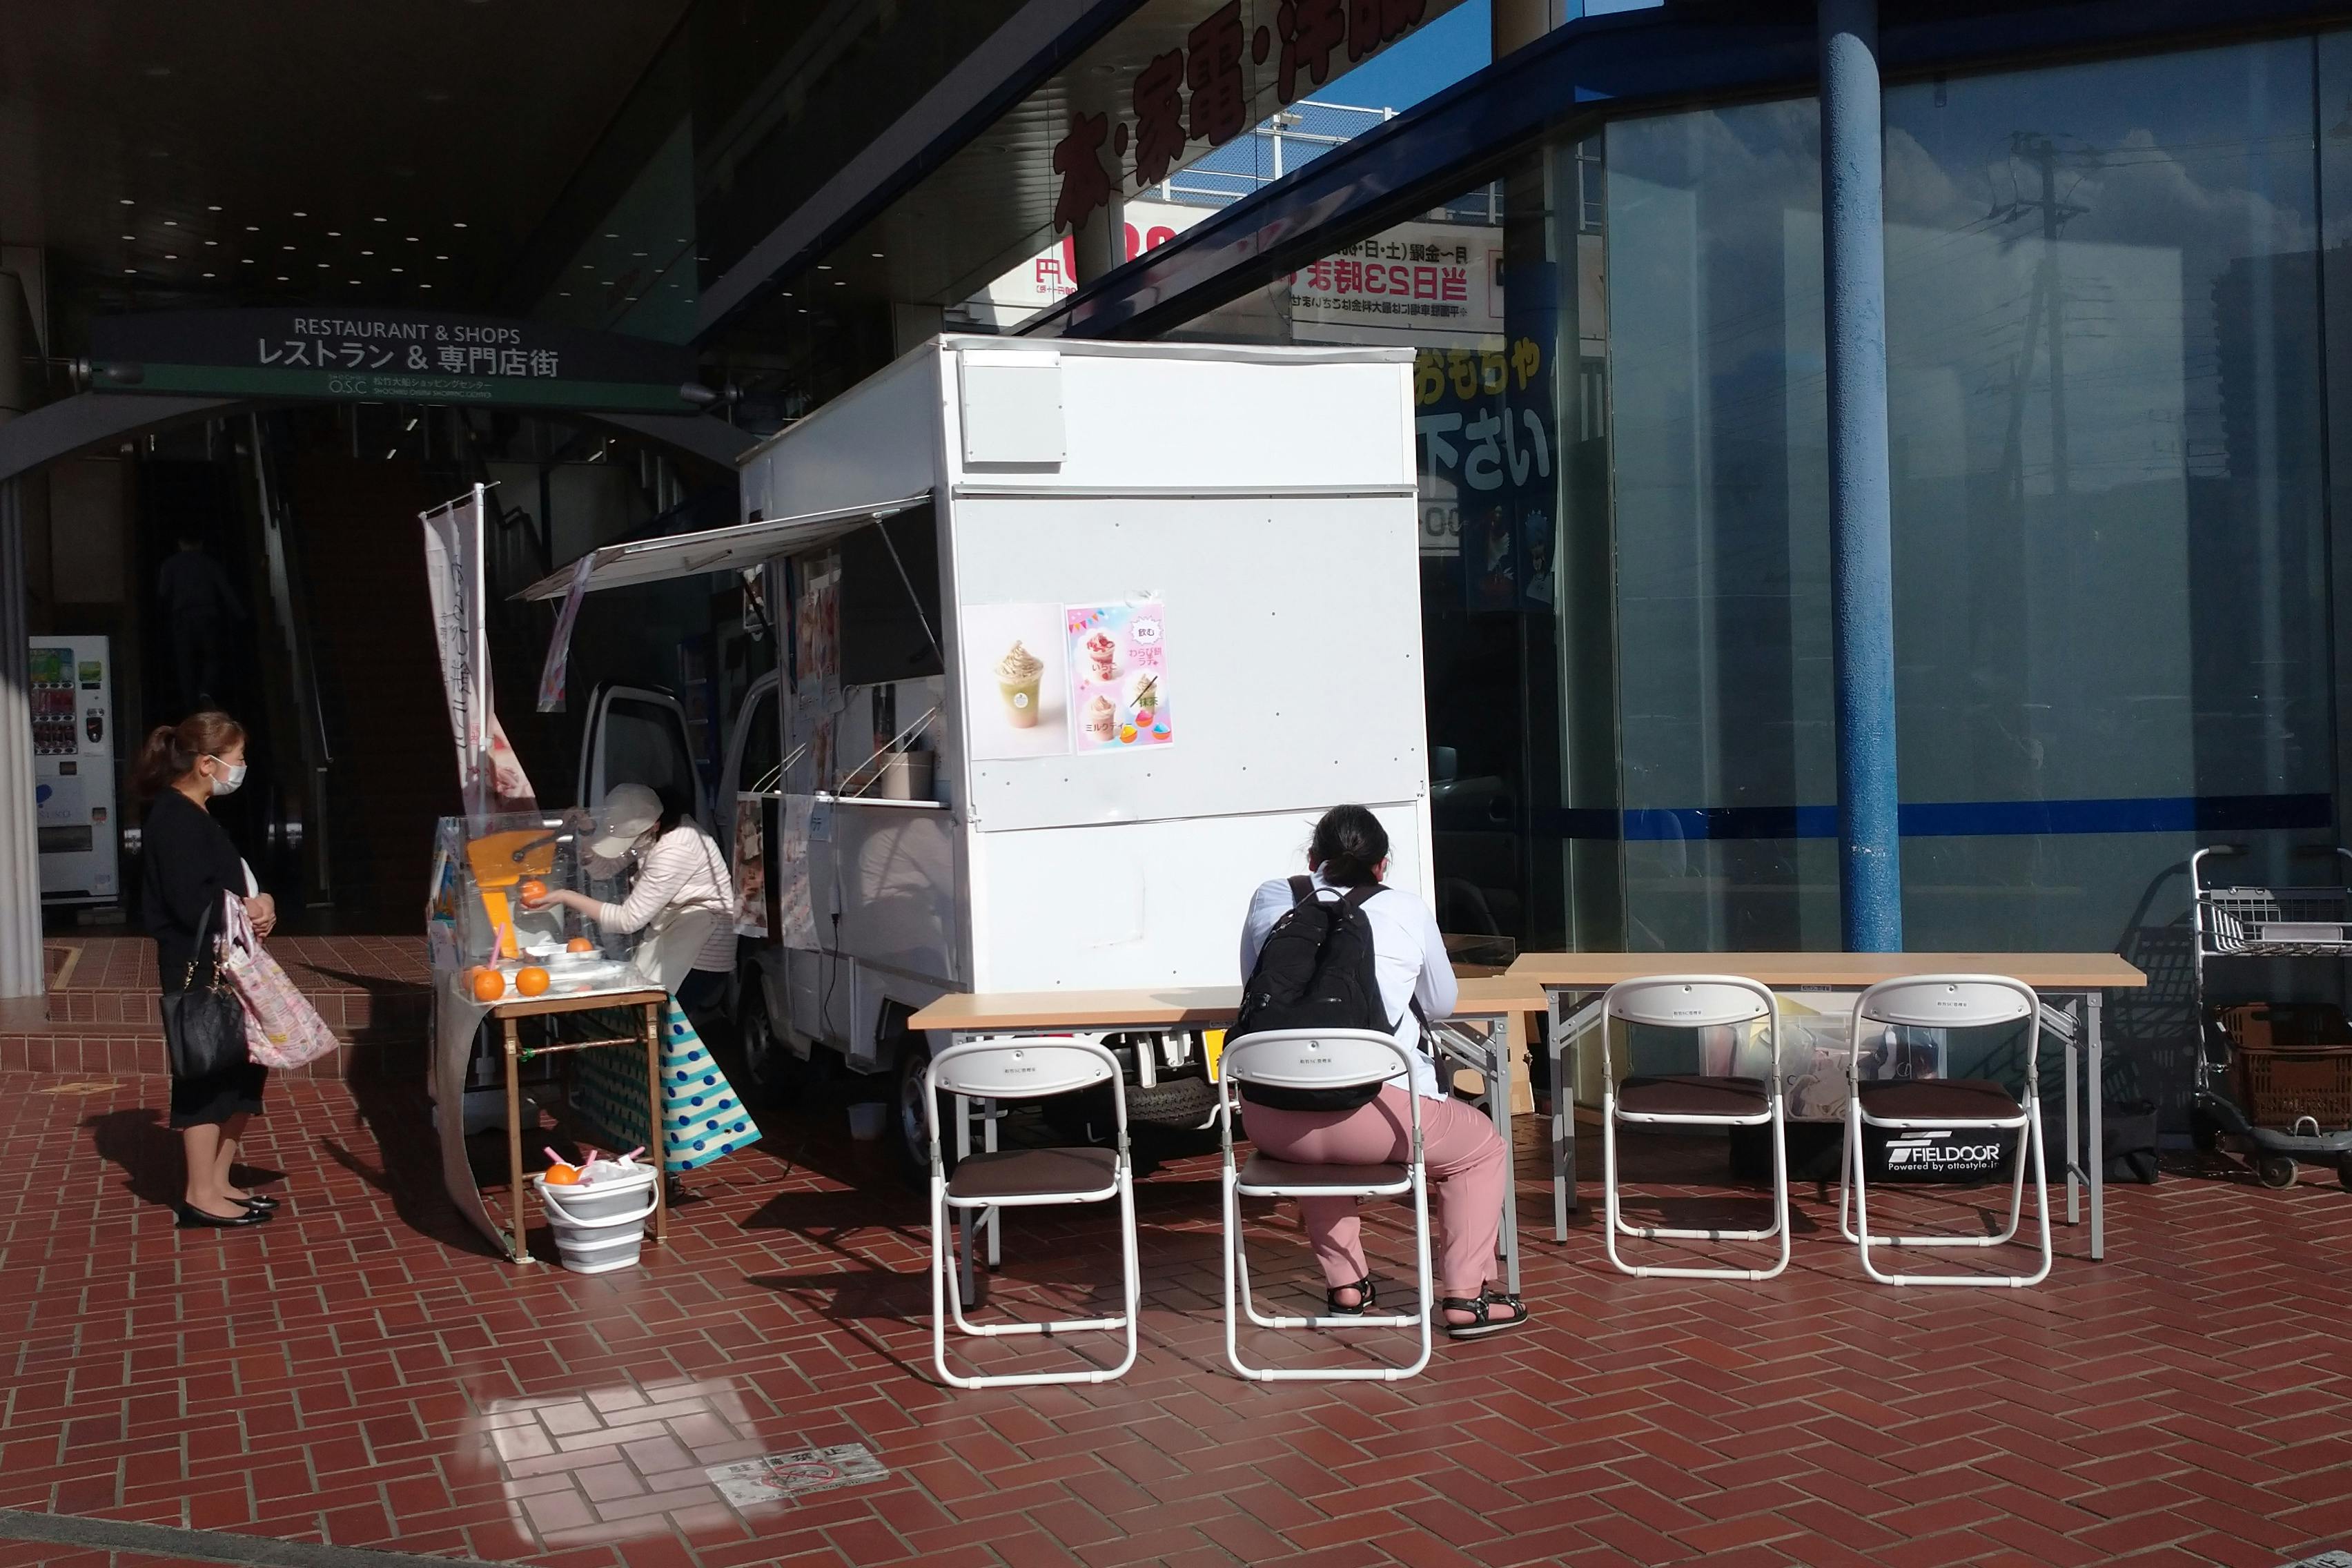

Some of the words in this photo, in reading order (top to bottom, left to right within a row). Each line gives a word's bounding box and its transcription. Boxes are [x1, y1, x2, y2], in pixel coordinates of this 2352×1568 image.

[294, 317, 430, 341] RESTAURANT
[435, 324, 450, 341] &
[453, 326, 521, 345] SHOPS
[258, 337, 395, 369] レストラン
[408, 344, 430, 371] &
[438, 344, 560, 378] 専門店街
[1138, 628, 1155, 637] 飲む
[1086, 722, 1133, 732] ミルクティー
[1912, 1145, 2000, 1162] FIELDOOR
[1888, 1162, 1929, 1171] Powered
[1932, 1162, 1944, 1172] by
